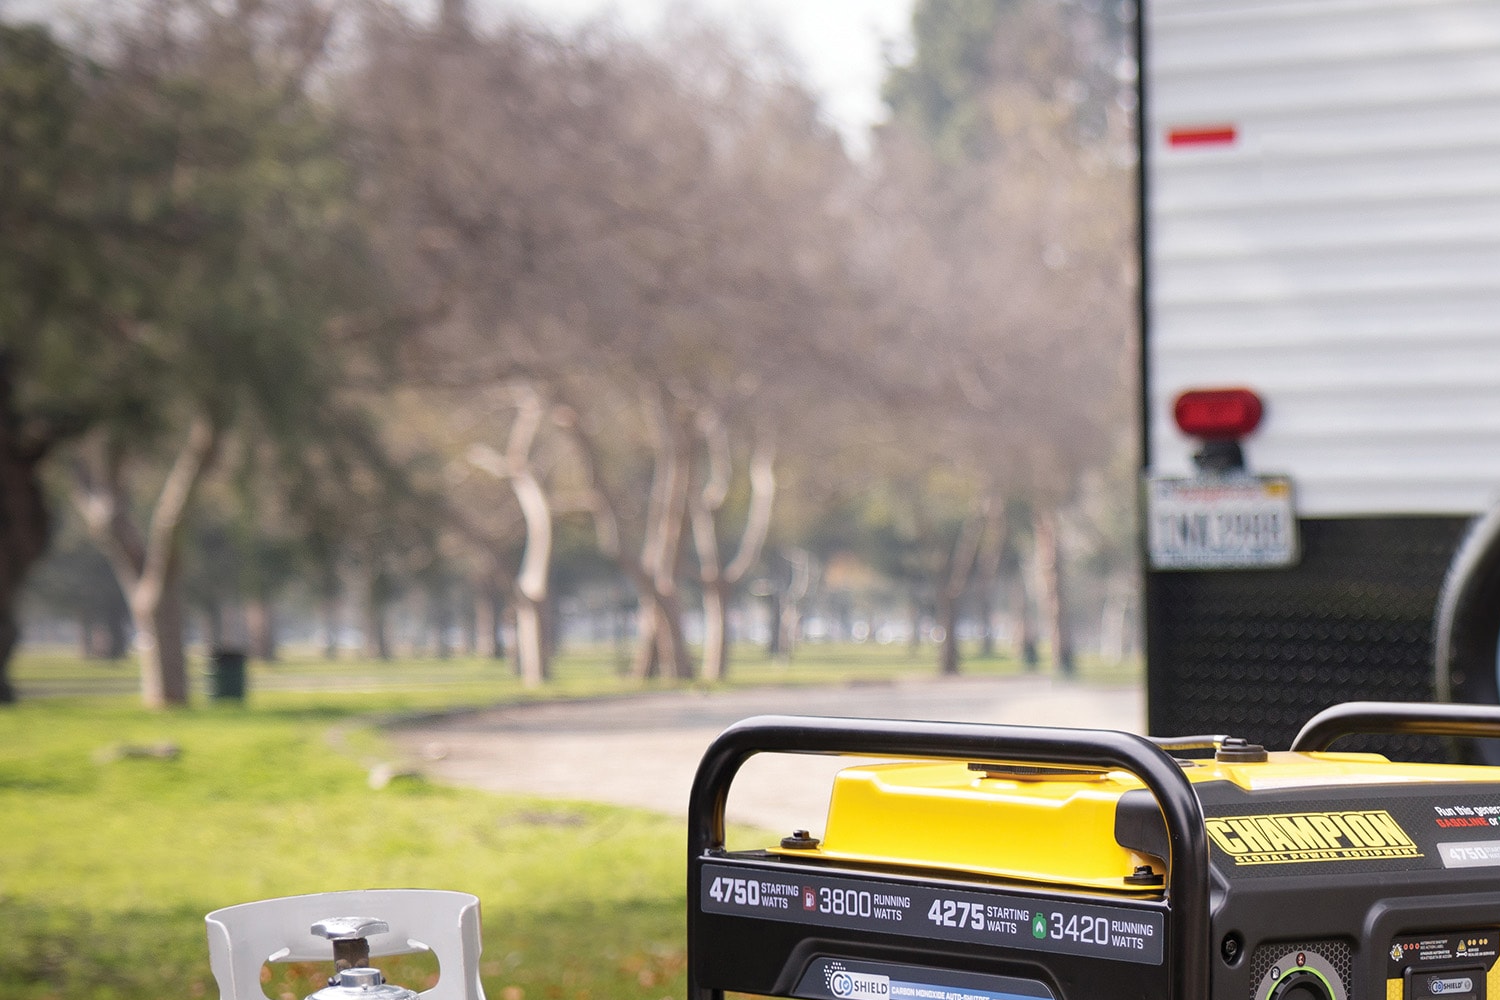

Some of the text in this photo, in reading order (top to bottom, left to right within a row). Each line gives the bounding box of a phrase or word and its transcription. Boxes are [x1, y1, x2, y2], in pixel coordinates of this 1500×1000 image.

[1434, 806, 1457, 817] Run
[1454, 805, 1474, 816] this
[1435, 817, 1489, 828] GASOLINE
[1488, 817, 1499, 826] or
[1205, 810, 1417, 855] CHAMPION
[1235, 848, 1418, 863] GLOBAL POWER EQUIPMENT
[1449, 847, 1489, 861] 4750
[709, 877, 799, 906] 4750 STARTING
[761, 896, 789, 909] WATTS
[819, 887, 911, 918] 3800 RUNNING
[873, 908, 902, 921] WATTS
[928, 899, 1029, 930] 4275 STARTING
[987, 919, 1017, 934] WATTS
[1050, 912, 1154, 945] 3420 RUNNING
[1111, 934, 1144, 949] WATTS
[854, 980, 888, 996] SHIELD
[891, 986, 915, 997] CARBON
[915, 988, 946, 1000] MONOXIDE
[1443, 982, 1462, 990] SHIELD
